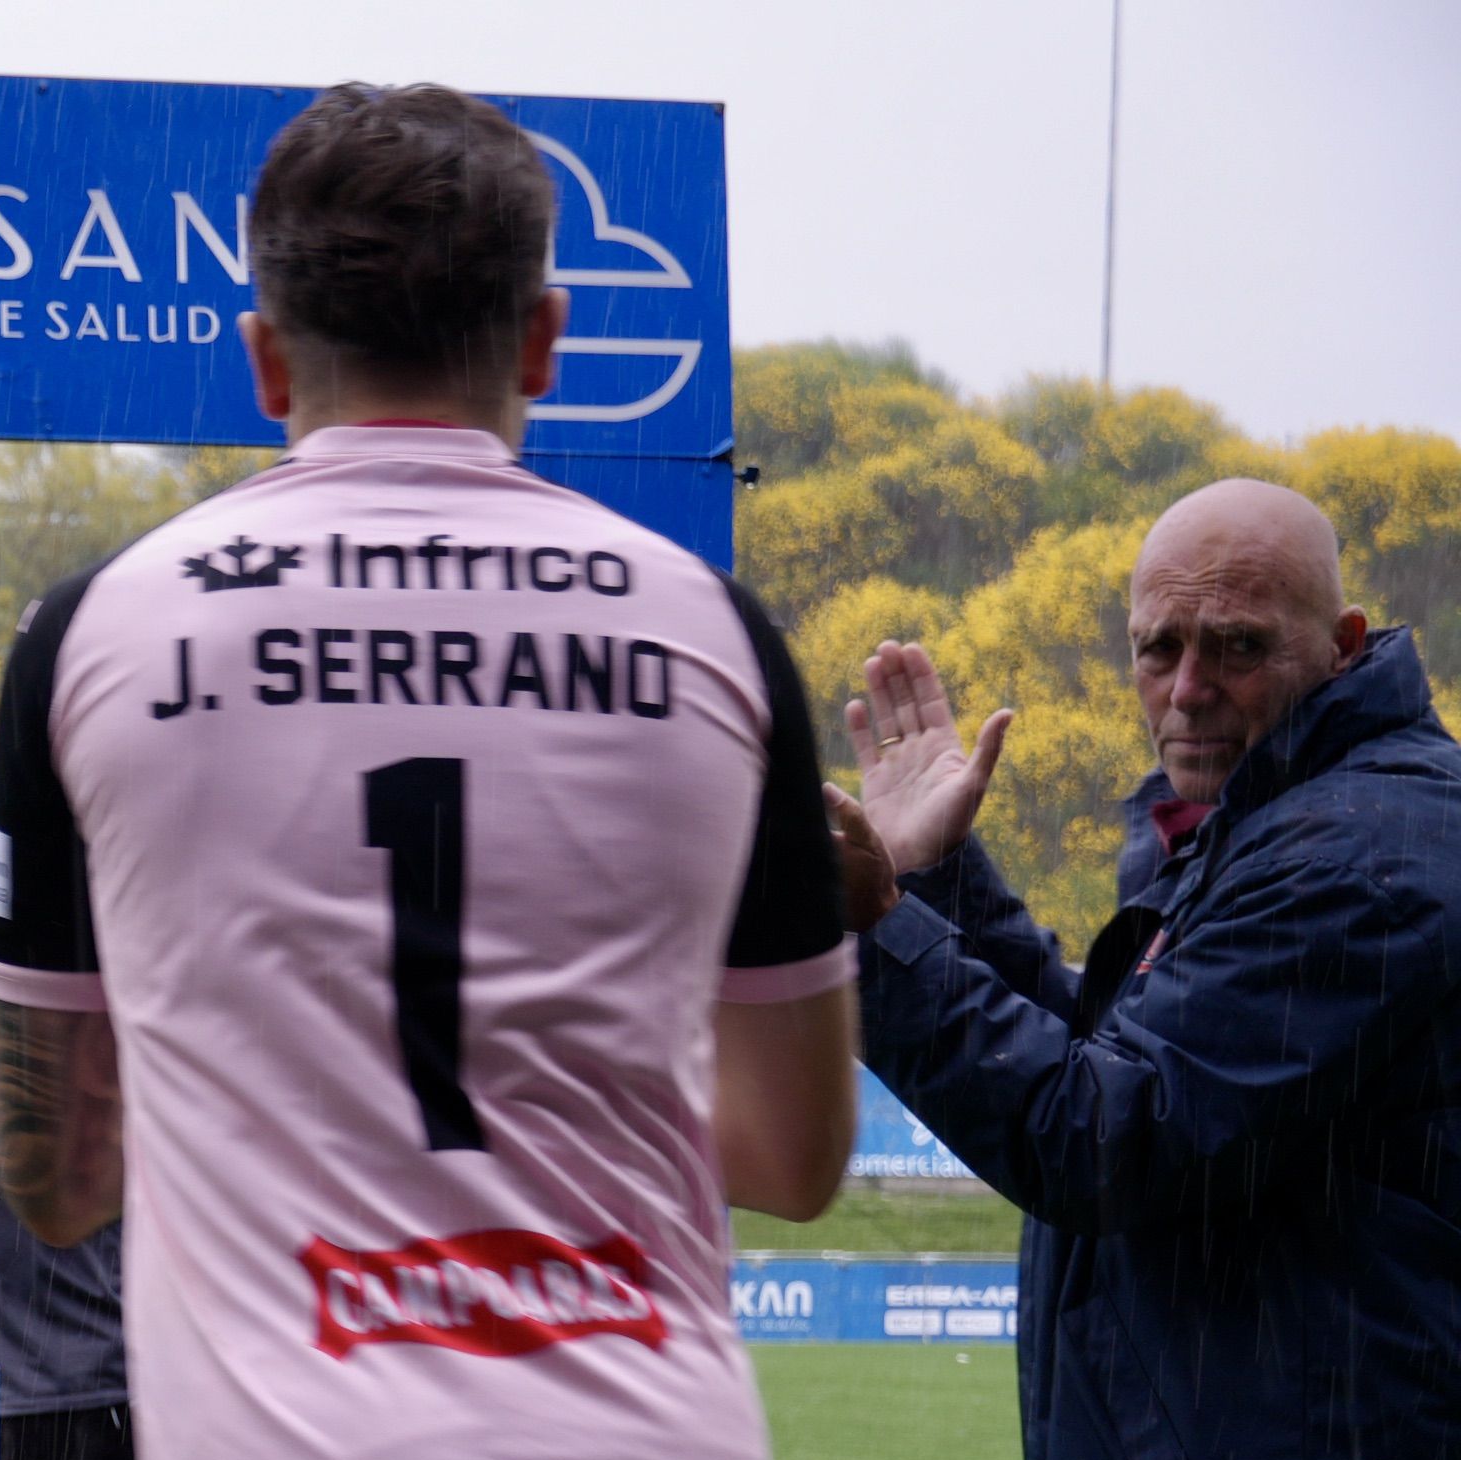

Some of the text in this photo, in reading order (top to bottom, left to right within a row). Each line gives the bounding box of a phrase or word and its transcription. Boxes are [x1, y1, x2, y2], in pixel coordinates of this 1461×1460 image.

[43, 301, 222, 345] SALUD
[327, 533, 634, 597] Infrico
[148, 627, 674, 720] J. SERRANO
[362, 756, 492, 1153] 1
